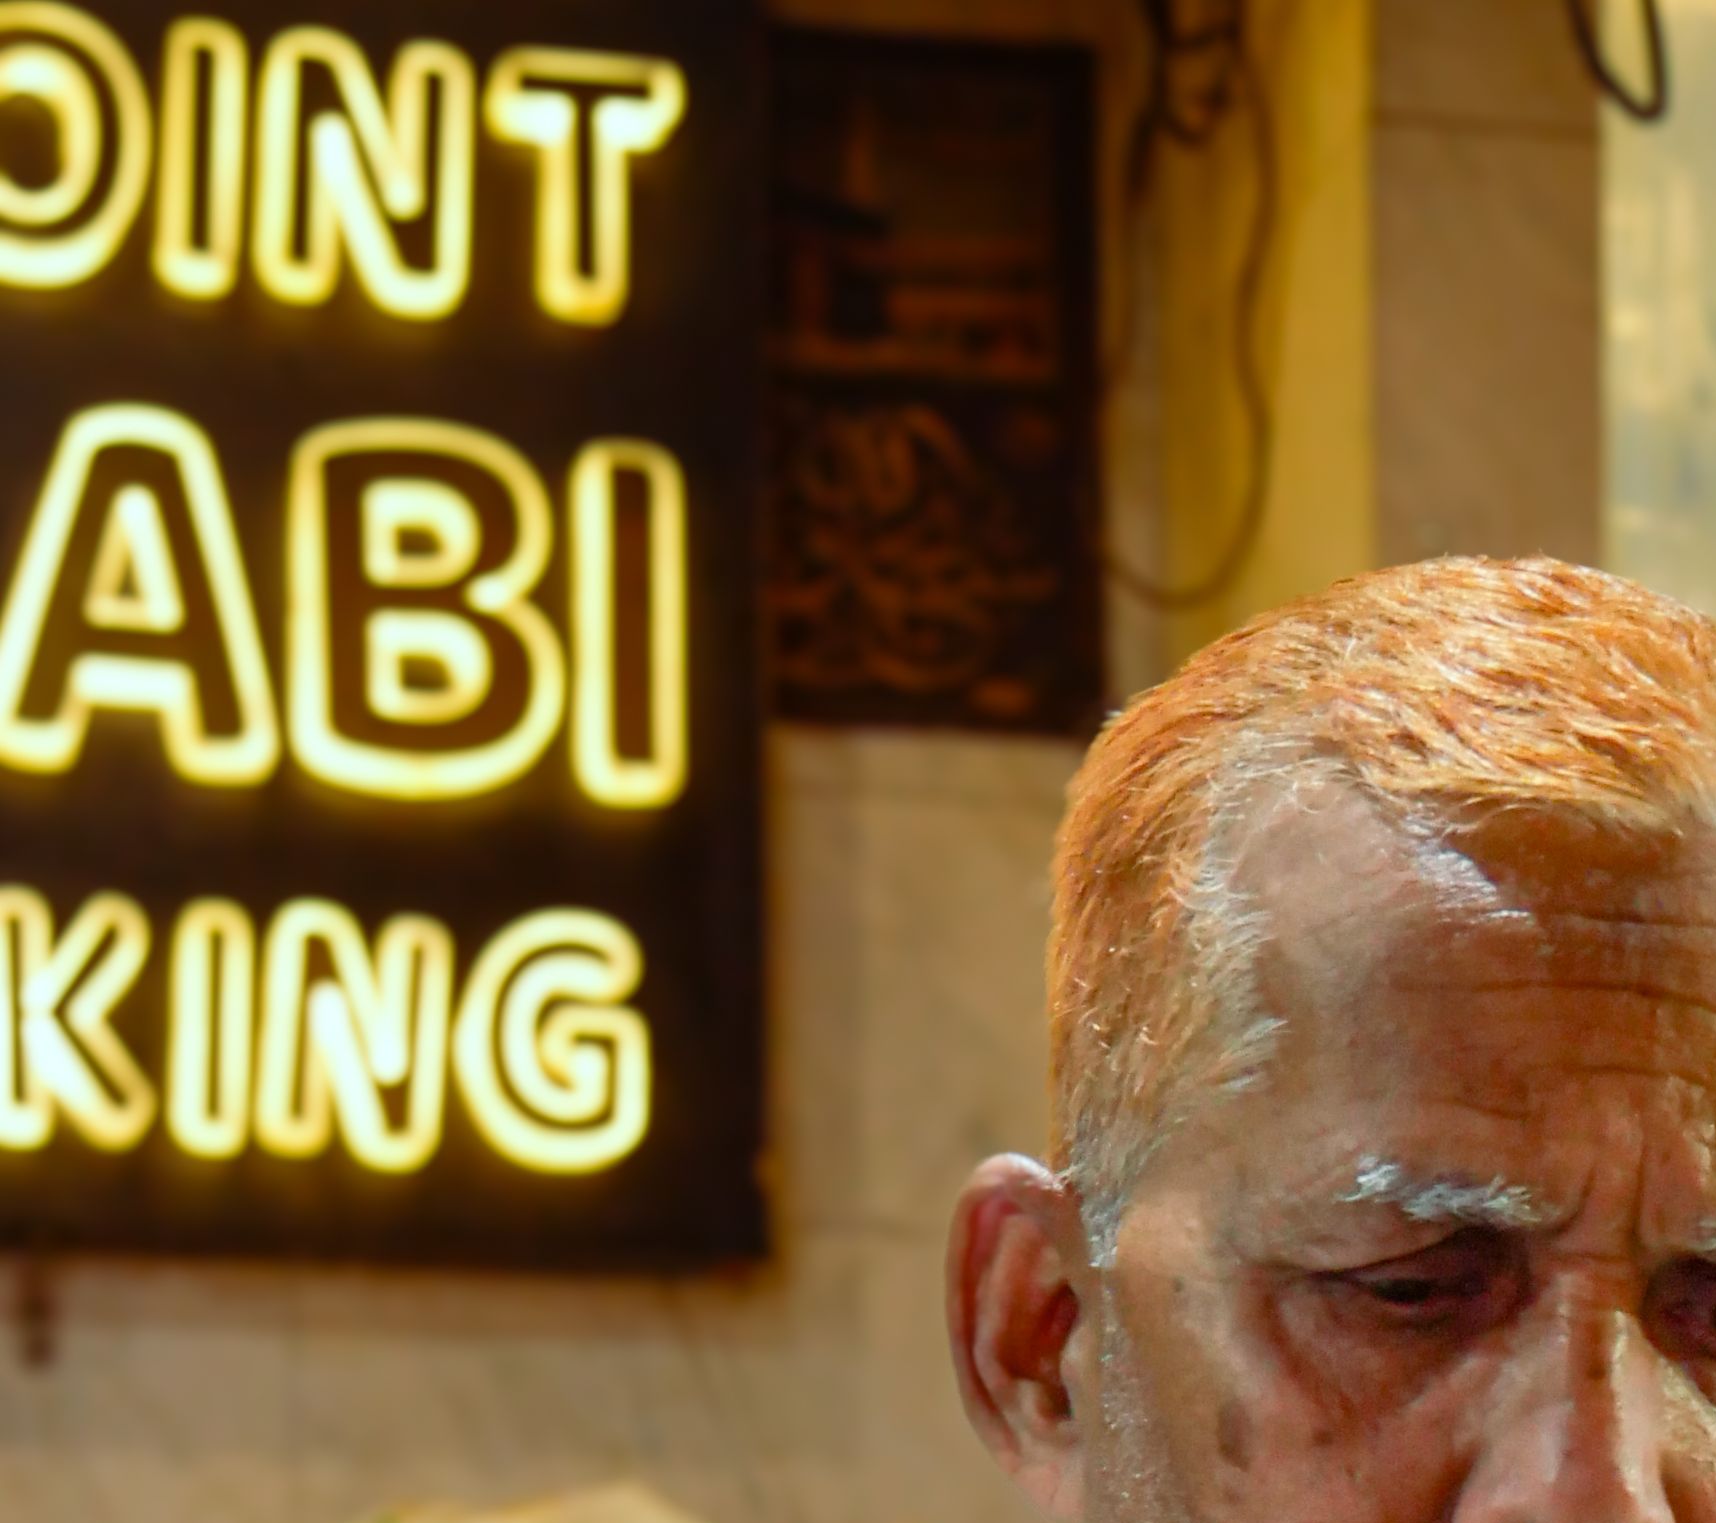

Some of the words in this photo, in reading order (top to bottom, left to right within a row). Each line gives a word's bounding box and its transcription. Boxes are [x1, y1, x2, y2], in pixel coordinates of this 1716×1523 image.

[0, 0, 686, 326] OINT
[0, 404, 688, 808] ABI
[0, 884, 652, 1174] KING
